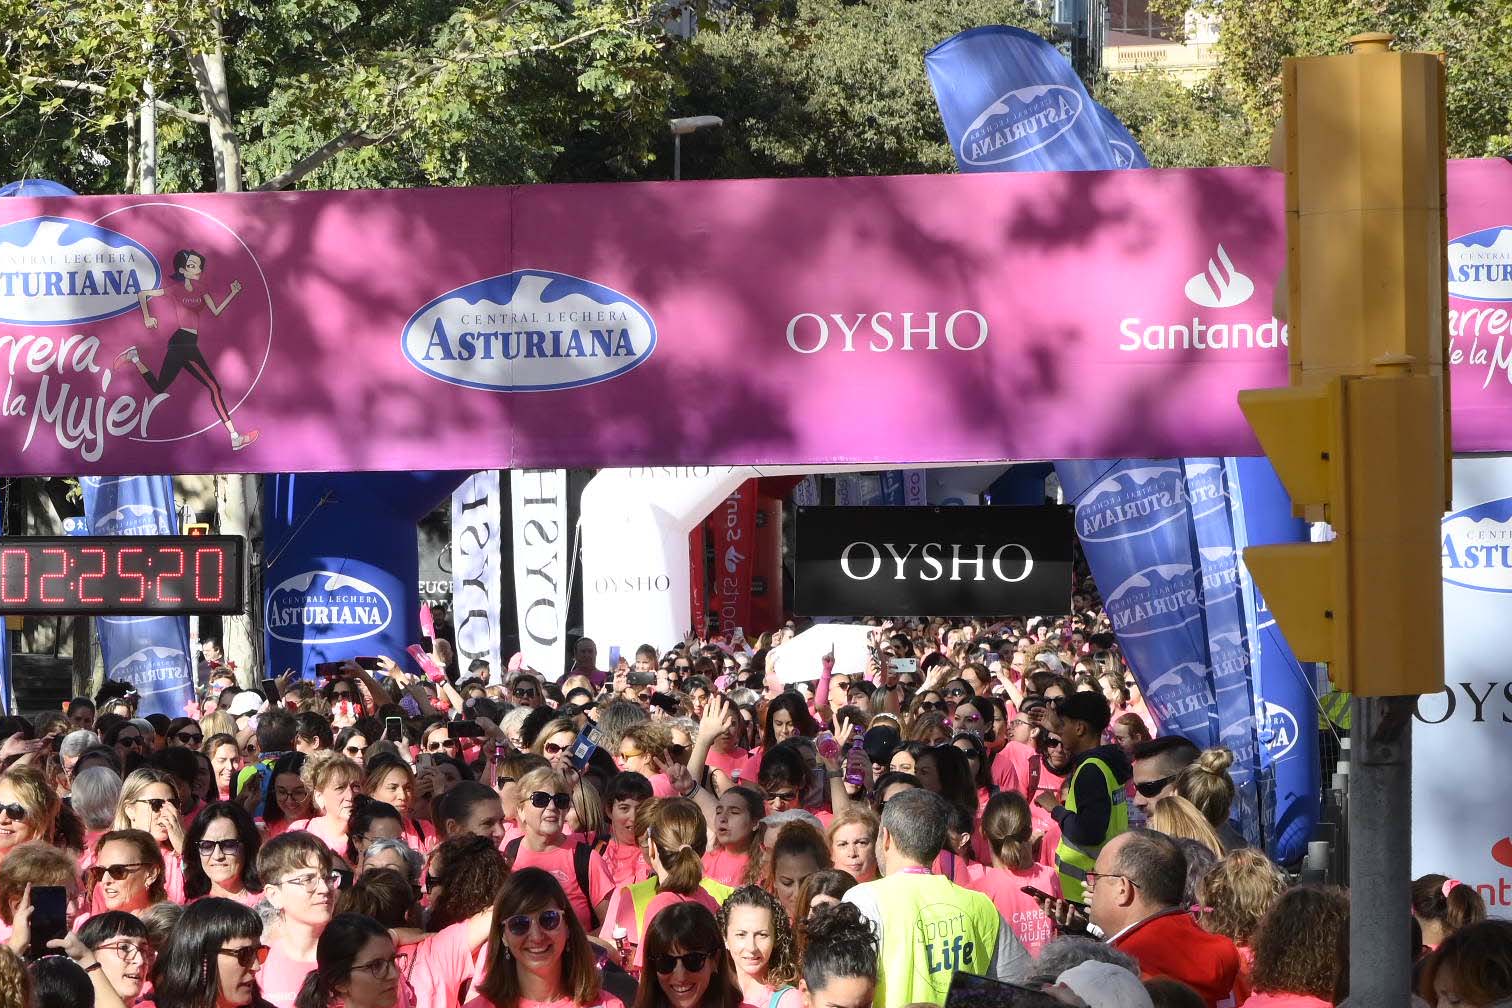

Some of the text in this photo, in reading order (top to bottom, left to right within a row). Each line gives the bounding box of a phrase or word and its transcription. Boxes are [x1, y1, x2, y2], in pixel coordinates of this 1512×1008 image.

[64, 252, 137, 264] LECHERA
[461, 310, 629, 326] CENTRAL LECHERA
[786, 309, 989, 355] OYSHO
[422, 316, 637, 362] ASTURIANA
[1469, 335, 1488, 367] la
[1, 376, 28, 418] la
[21, 368, 172, 464] Mujer
[1, 548, 223, 602] 02:25:20
[840, 541, 1034, 582] OYSHO
[282, 594, 378, 604] CENTRAL LECHERA
[594, 575, 671, 593] OYSHO
[270, 600, 382, 627] ASTURIANA
[916, 911, 966, 943] Sport
[1021, 919, 1049, 932] DE LA
[926, 935, 974, 974] Life
